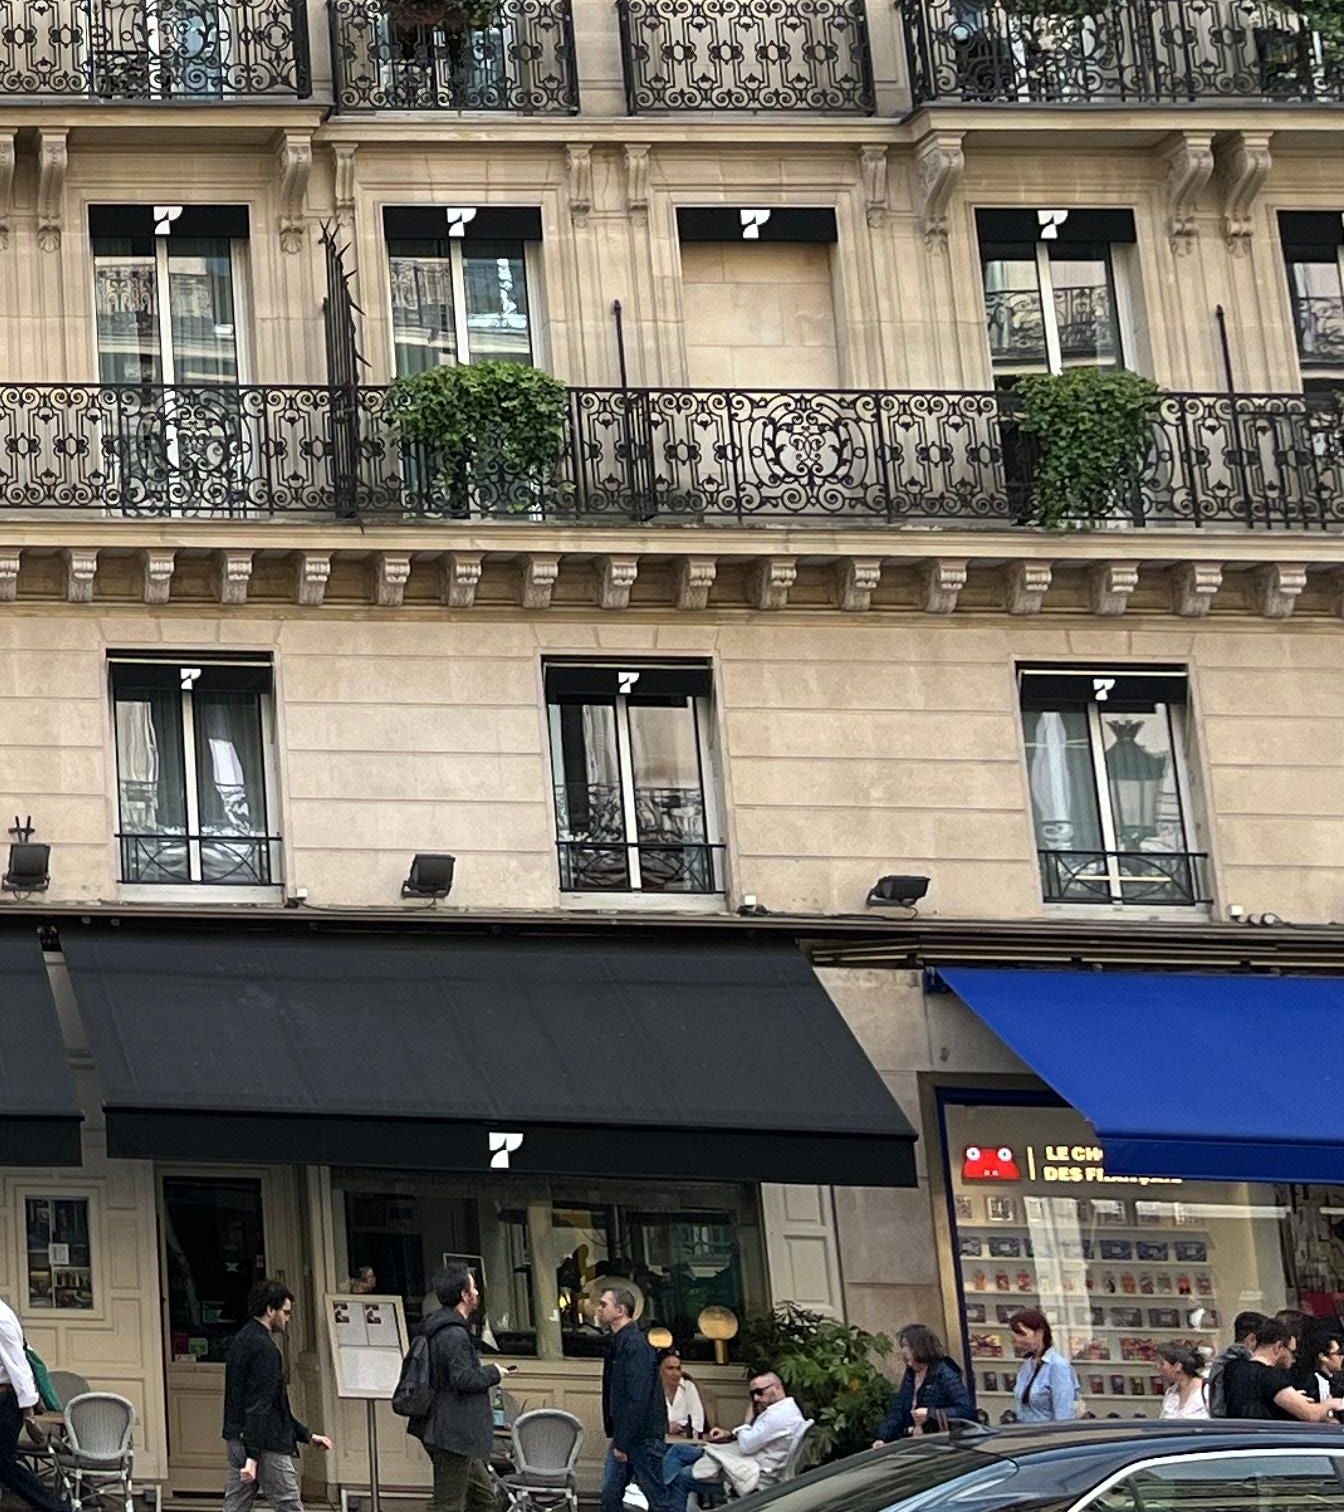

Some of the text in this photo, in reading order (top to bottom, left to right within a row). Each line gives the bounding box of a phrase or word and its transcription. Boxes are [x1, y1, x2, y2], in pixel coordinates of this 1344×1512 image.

[1045, 1145, 1104, 1163] LE CH
[1043, 1166, 1084, 1182] DES
